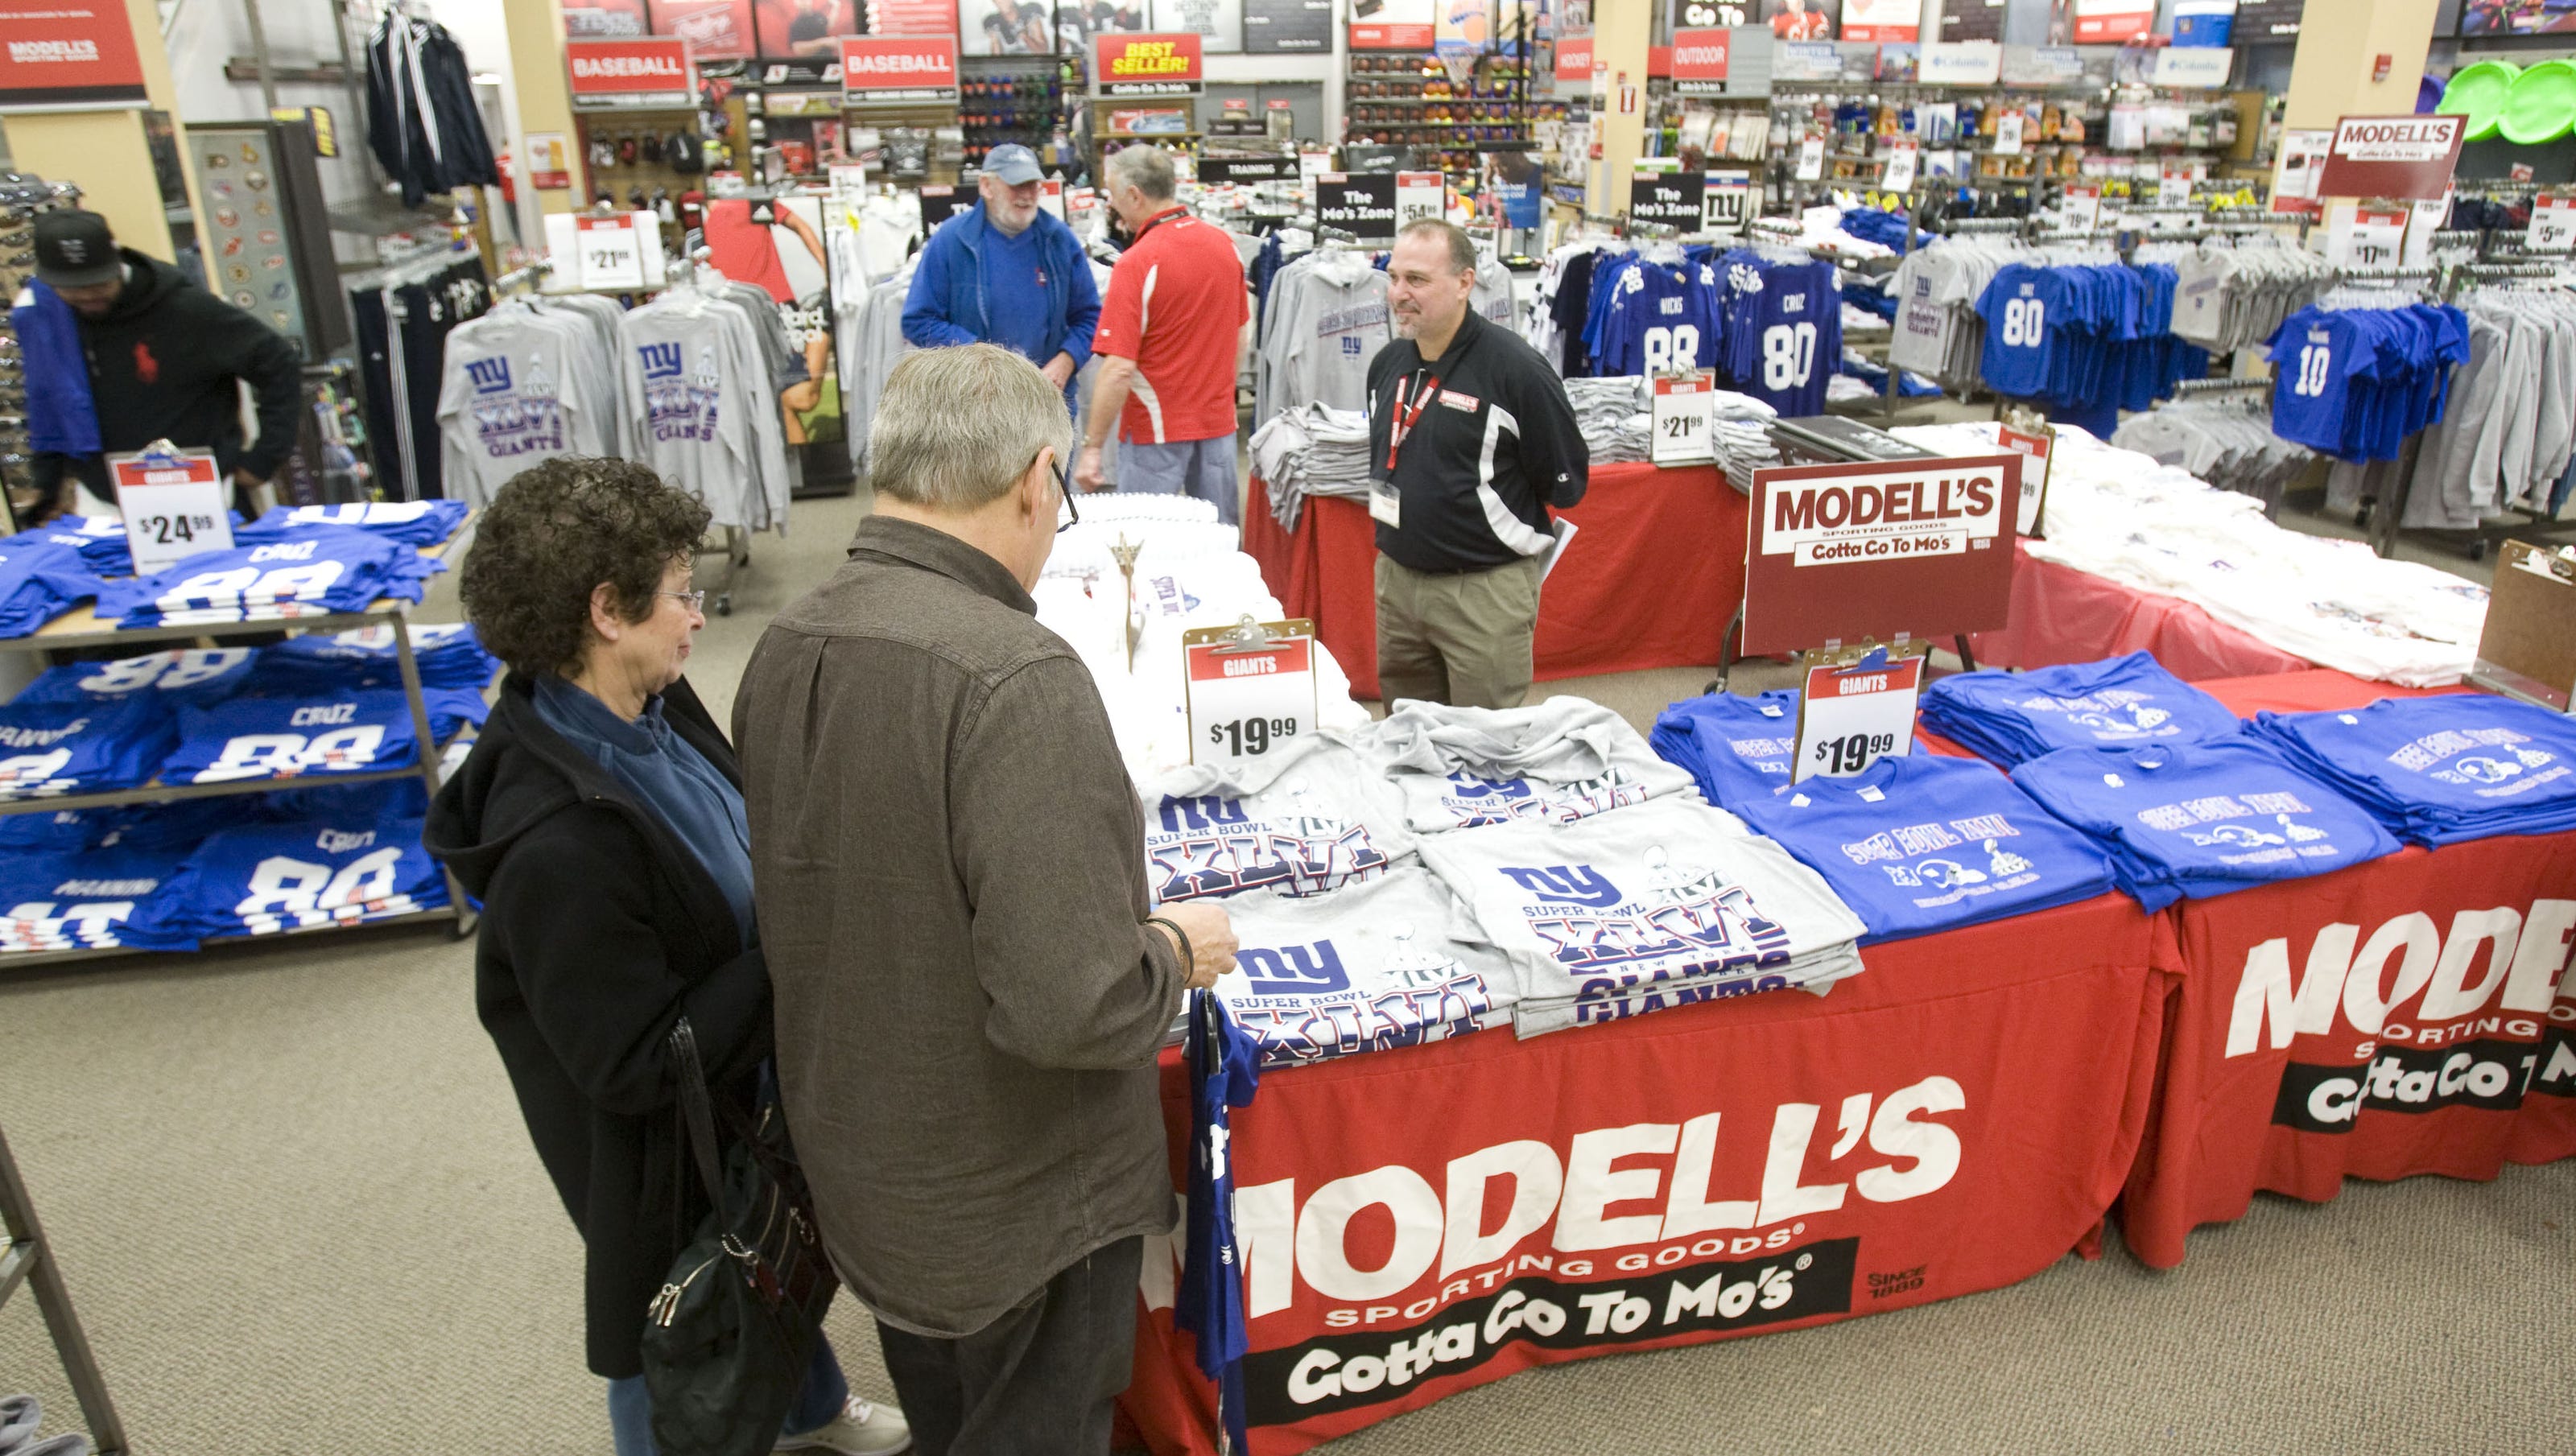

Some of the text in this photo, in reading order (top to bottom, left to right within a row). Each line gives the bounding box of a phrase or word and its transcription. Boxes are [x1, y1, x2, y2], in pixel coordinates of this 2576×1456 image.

[1686, 5, 1745, 27] Go To
[1125, 42, 1175, 57] BEST
[1675, 46, 1725, 65] OUTDOOR
[572, 56, 683, 77] BASEBALL
[848, 54, 951, 73] BASEBALL
[1112, 56, 1189, 74] SELLER!
[2344, 124, 2451, 143] MODELL'S
[1228, 163, 1275, 175] TRAINING
[1343, 190, 1373, 204] The
[1654, 187, 1682, 201] The
[1322, 206, 1395, 220] Mo's Zone
[1633, 203, 1701, 217] Mo's Zone
[1782, 293, 1806, 314] CRUZ
[2002, 298, 2045, 348] 80
[638, 341, 683, 379] ny
[1644, 324, 1700, 389] 88
[1763, 321, 1817, 391] 80
[464, 355, 512, 394] ny
[2294, 345, 2331, 397] 10
[488, 435, 564, 458] GIANTS
[1774, 476, 1995, 532] MODELL'S
[1822, 522, 1948, 538] SPORTING GOODS
[248, 540, 320, 563] CRUZ
[1811, 534, 1951, 561] Gotta Go To Mo's
[1223, 656, 1277, 677] GIANTS
[1839, 674, 1888, 695] GIANTS
[291, 703, 358, 726] CRUZ
[1218, 822, 1273, 835] BOWL
[1498, 864, 1623, 908] ny
[1521, 905, 1584, 918] SUPER
[1528, 885, 1787, 969] XLVI
[1236, 938, 1352, 996] ny
[1620, 945, 1748, 973] NEW YORK
[1231, 989, 1373, 1008] SUPER BOWL
[2354, 1017, 2539, 1060] SORTING
[2307, 1055, 2438, 1123] Gtta
[1324, 1253, 1593, 1328] SPORTING
[1288, 1322, 1478, 1404] Gotta
[1483, 1289, 1567, 1345] Go
[1578, 1289, 1651, 1335] To
